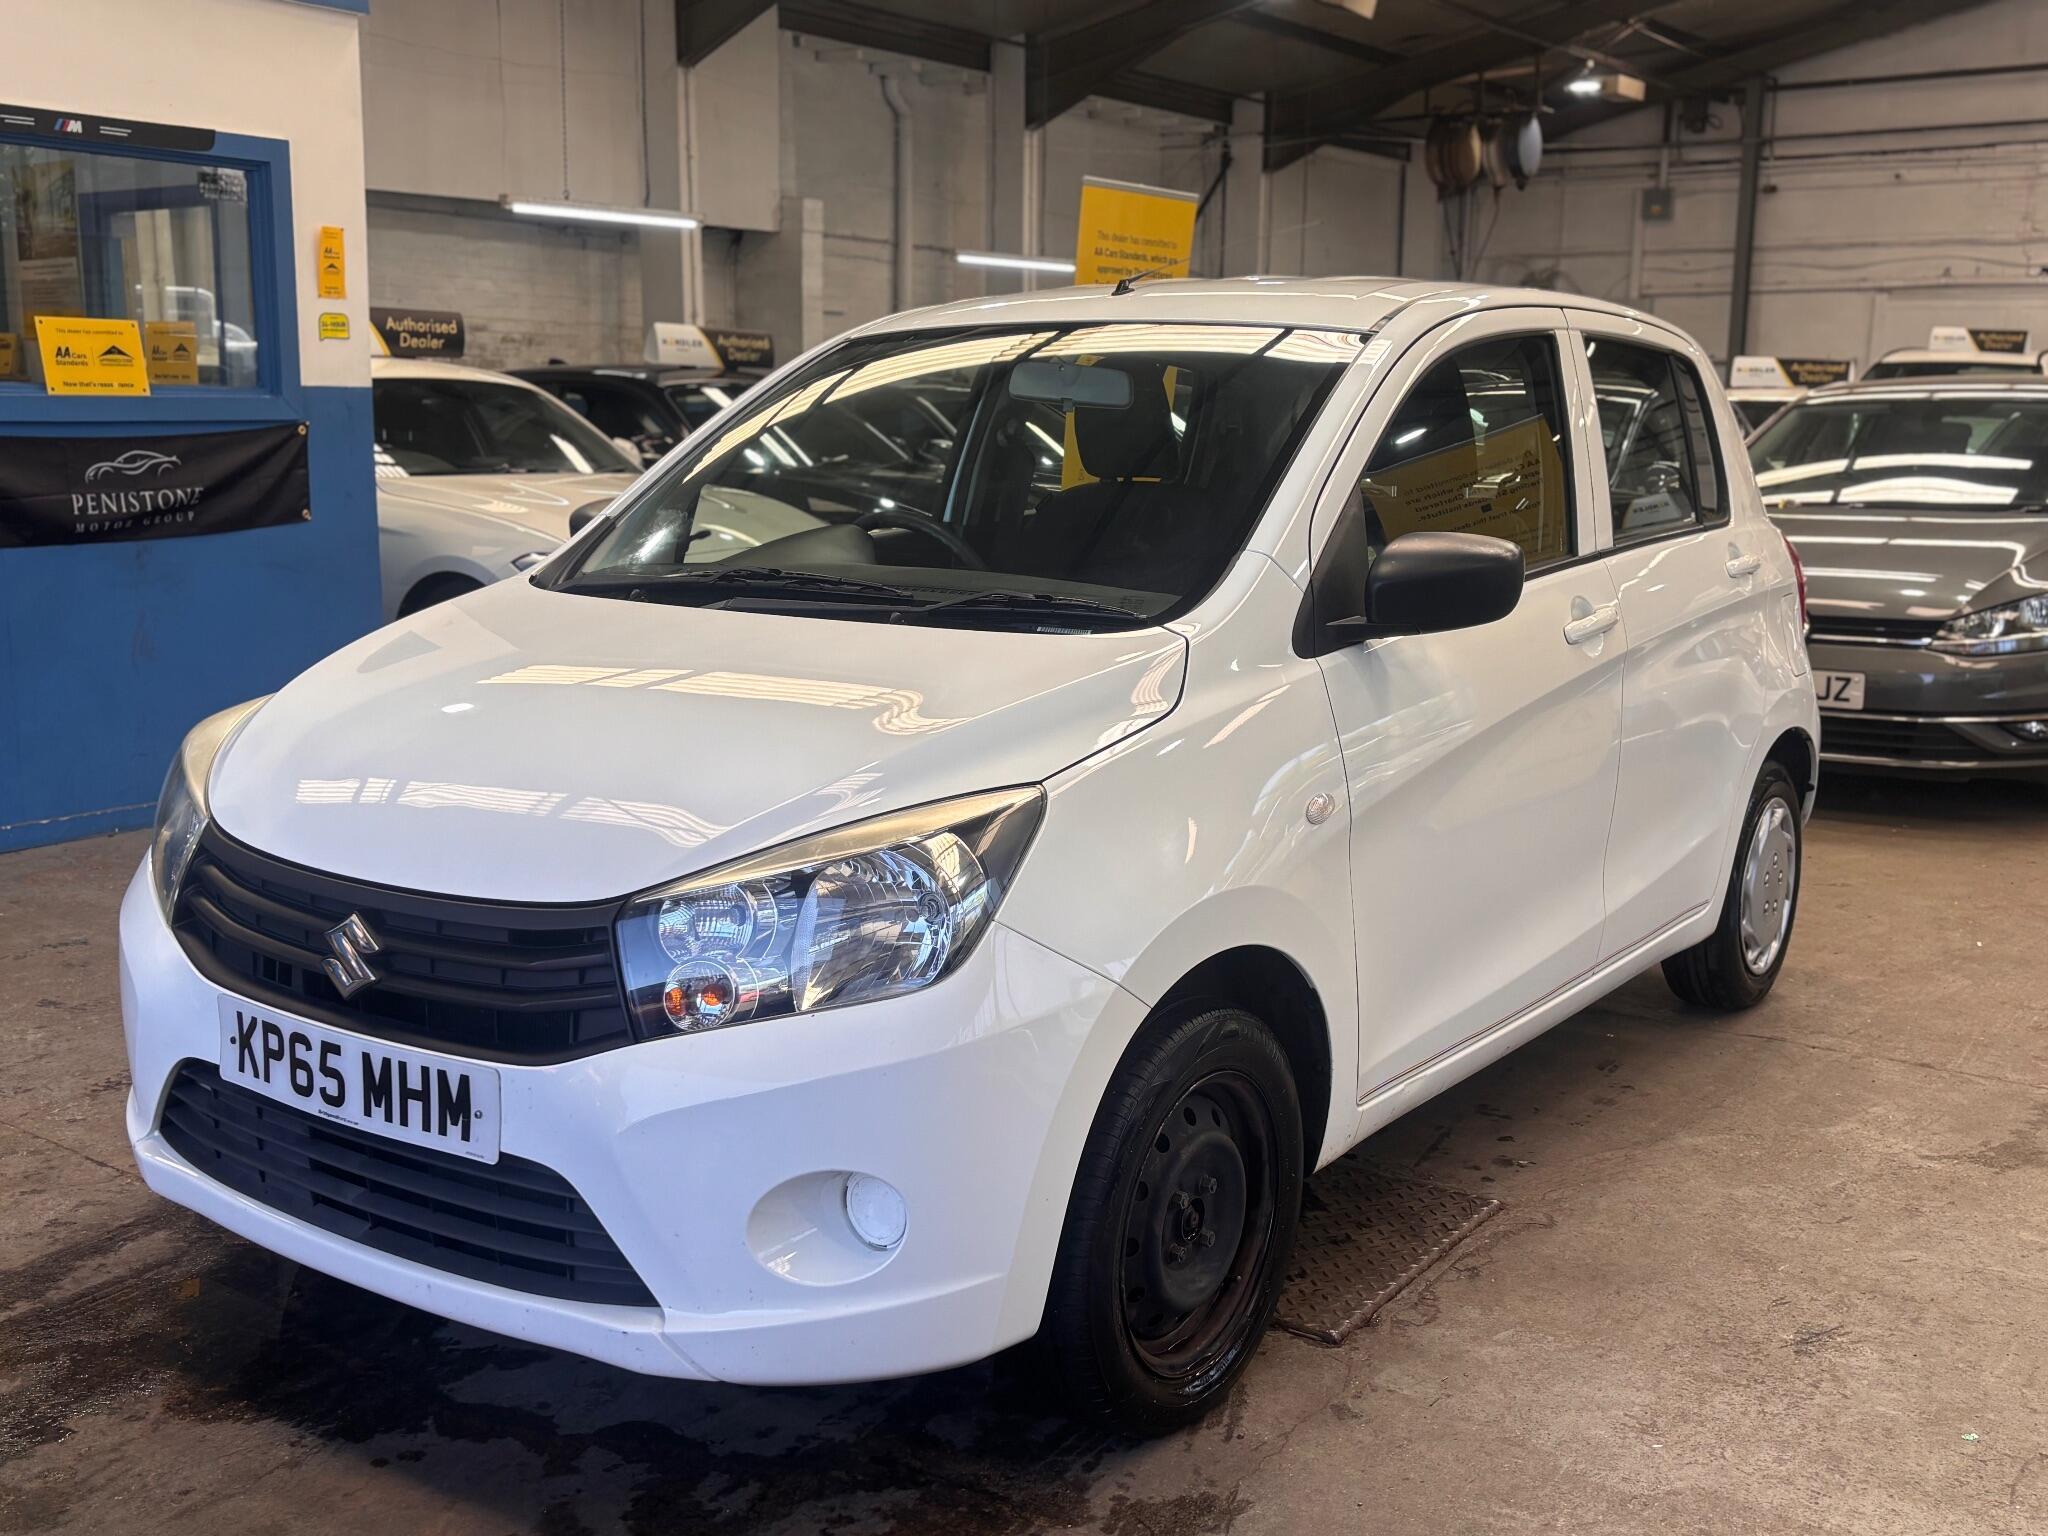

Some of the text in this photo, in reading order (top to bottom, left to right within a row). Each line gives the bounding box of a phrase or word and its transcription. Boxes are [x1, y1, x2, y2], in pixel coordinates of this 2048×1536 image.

[386, 316, 457, 334] Authorised
[400, 332, 445, 349] Dealer
[55, 346, 71, 358] AA
[55, 359, 89, 367] Standards
[71, 487, 204, 515] PENISTONE
[75, 511, 195, 533] MOTOR GROUP
[236, 1010, 471, 1143] KP65 MHM
